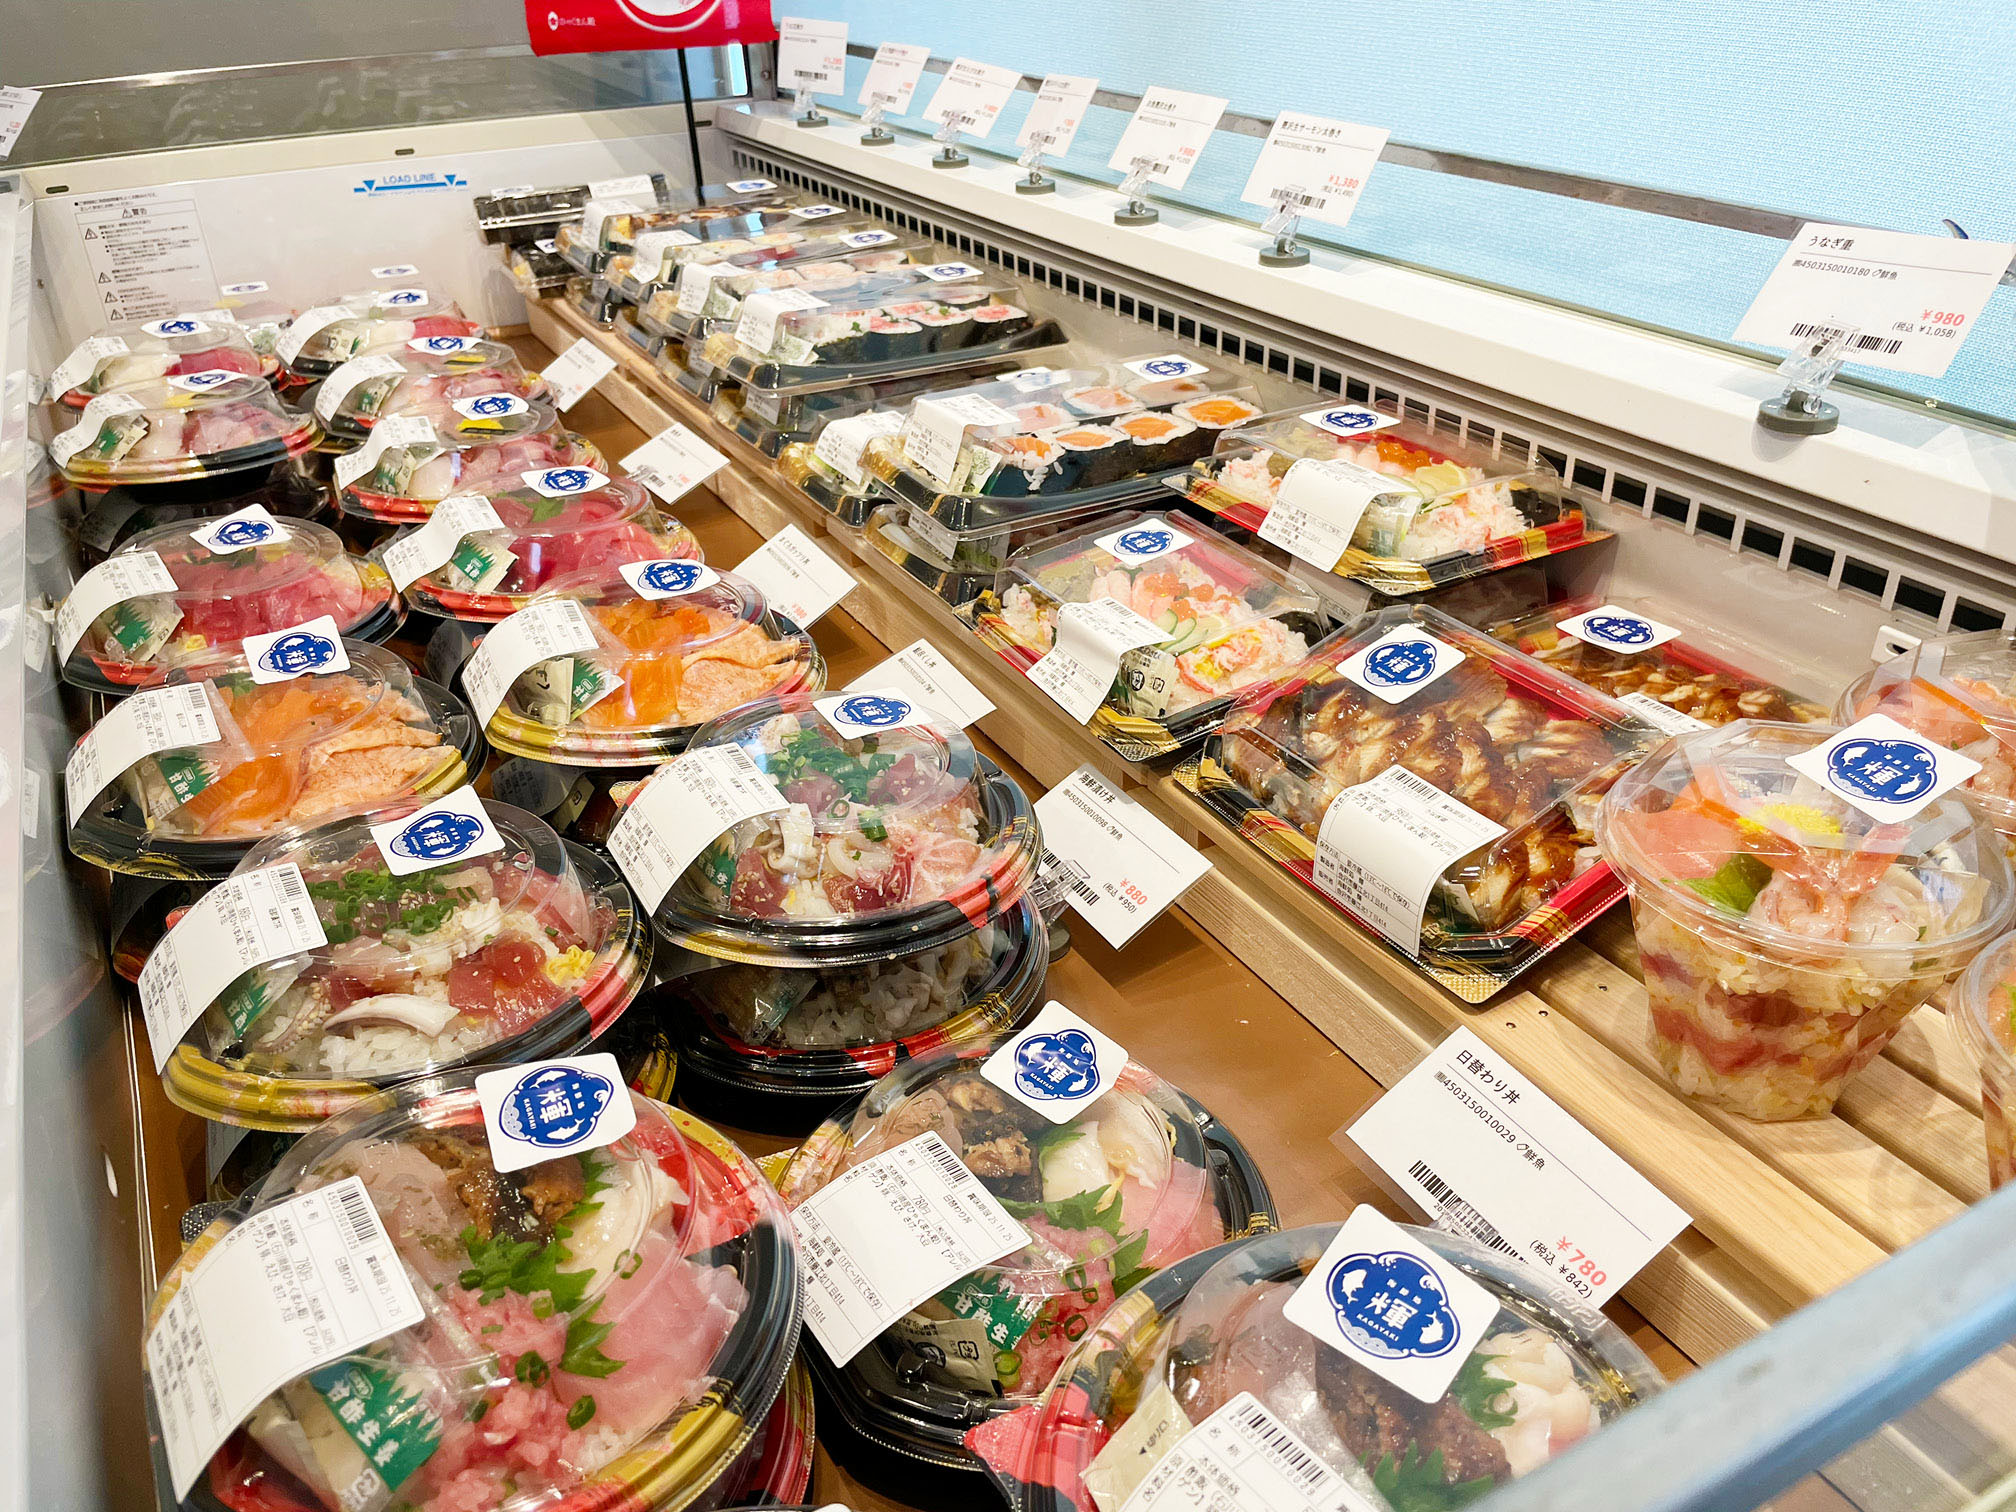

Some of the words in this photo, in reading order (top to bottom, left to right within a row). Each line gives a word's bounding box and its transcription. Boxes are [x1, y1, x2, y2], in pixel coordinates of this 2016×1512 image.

[383, 174, 411, 185] LOAD
[414, 172, 437, 182] LINE
[1809, 236, 1854, 250] うなぎ重
[1800, 260, 1870, 276] 4503150010180
[1880, 270, 1898, 280] 鮮魚
[1922, 309, 1965, 326] ¥980
[1077, 771, 1117, 805] 海鮮漬け丼
[1119, 877, 1149, 906] ¥880
[1030, 1072, 1055, 1091] KAGAYAKI
[1455, 1049, 1522, 1106] 日替わり丼
[523, 1098, 537, 1130] KAGAYAKI
[1441, 1078, 1517, 1145] 4503150010029
[1523, 1148, 1546, 1171] 鮮魚
[798, 1204, 822, 1232] 保存方法
[941, 1192, 974, 1225] 日替わり丼
[1528, 1238, 1557, 1266] (税込
[1557, 1264, 1594, 1299] ¥842)
[1555, 1234, 1607, 1287] ¥780
[1356, 1313, 1400, 1342] KAGAYAKI
